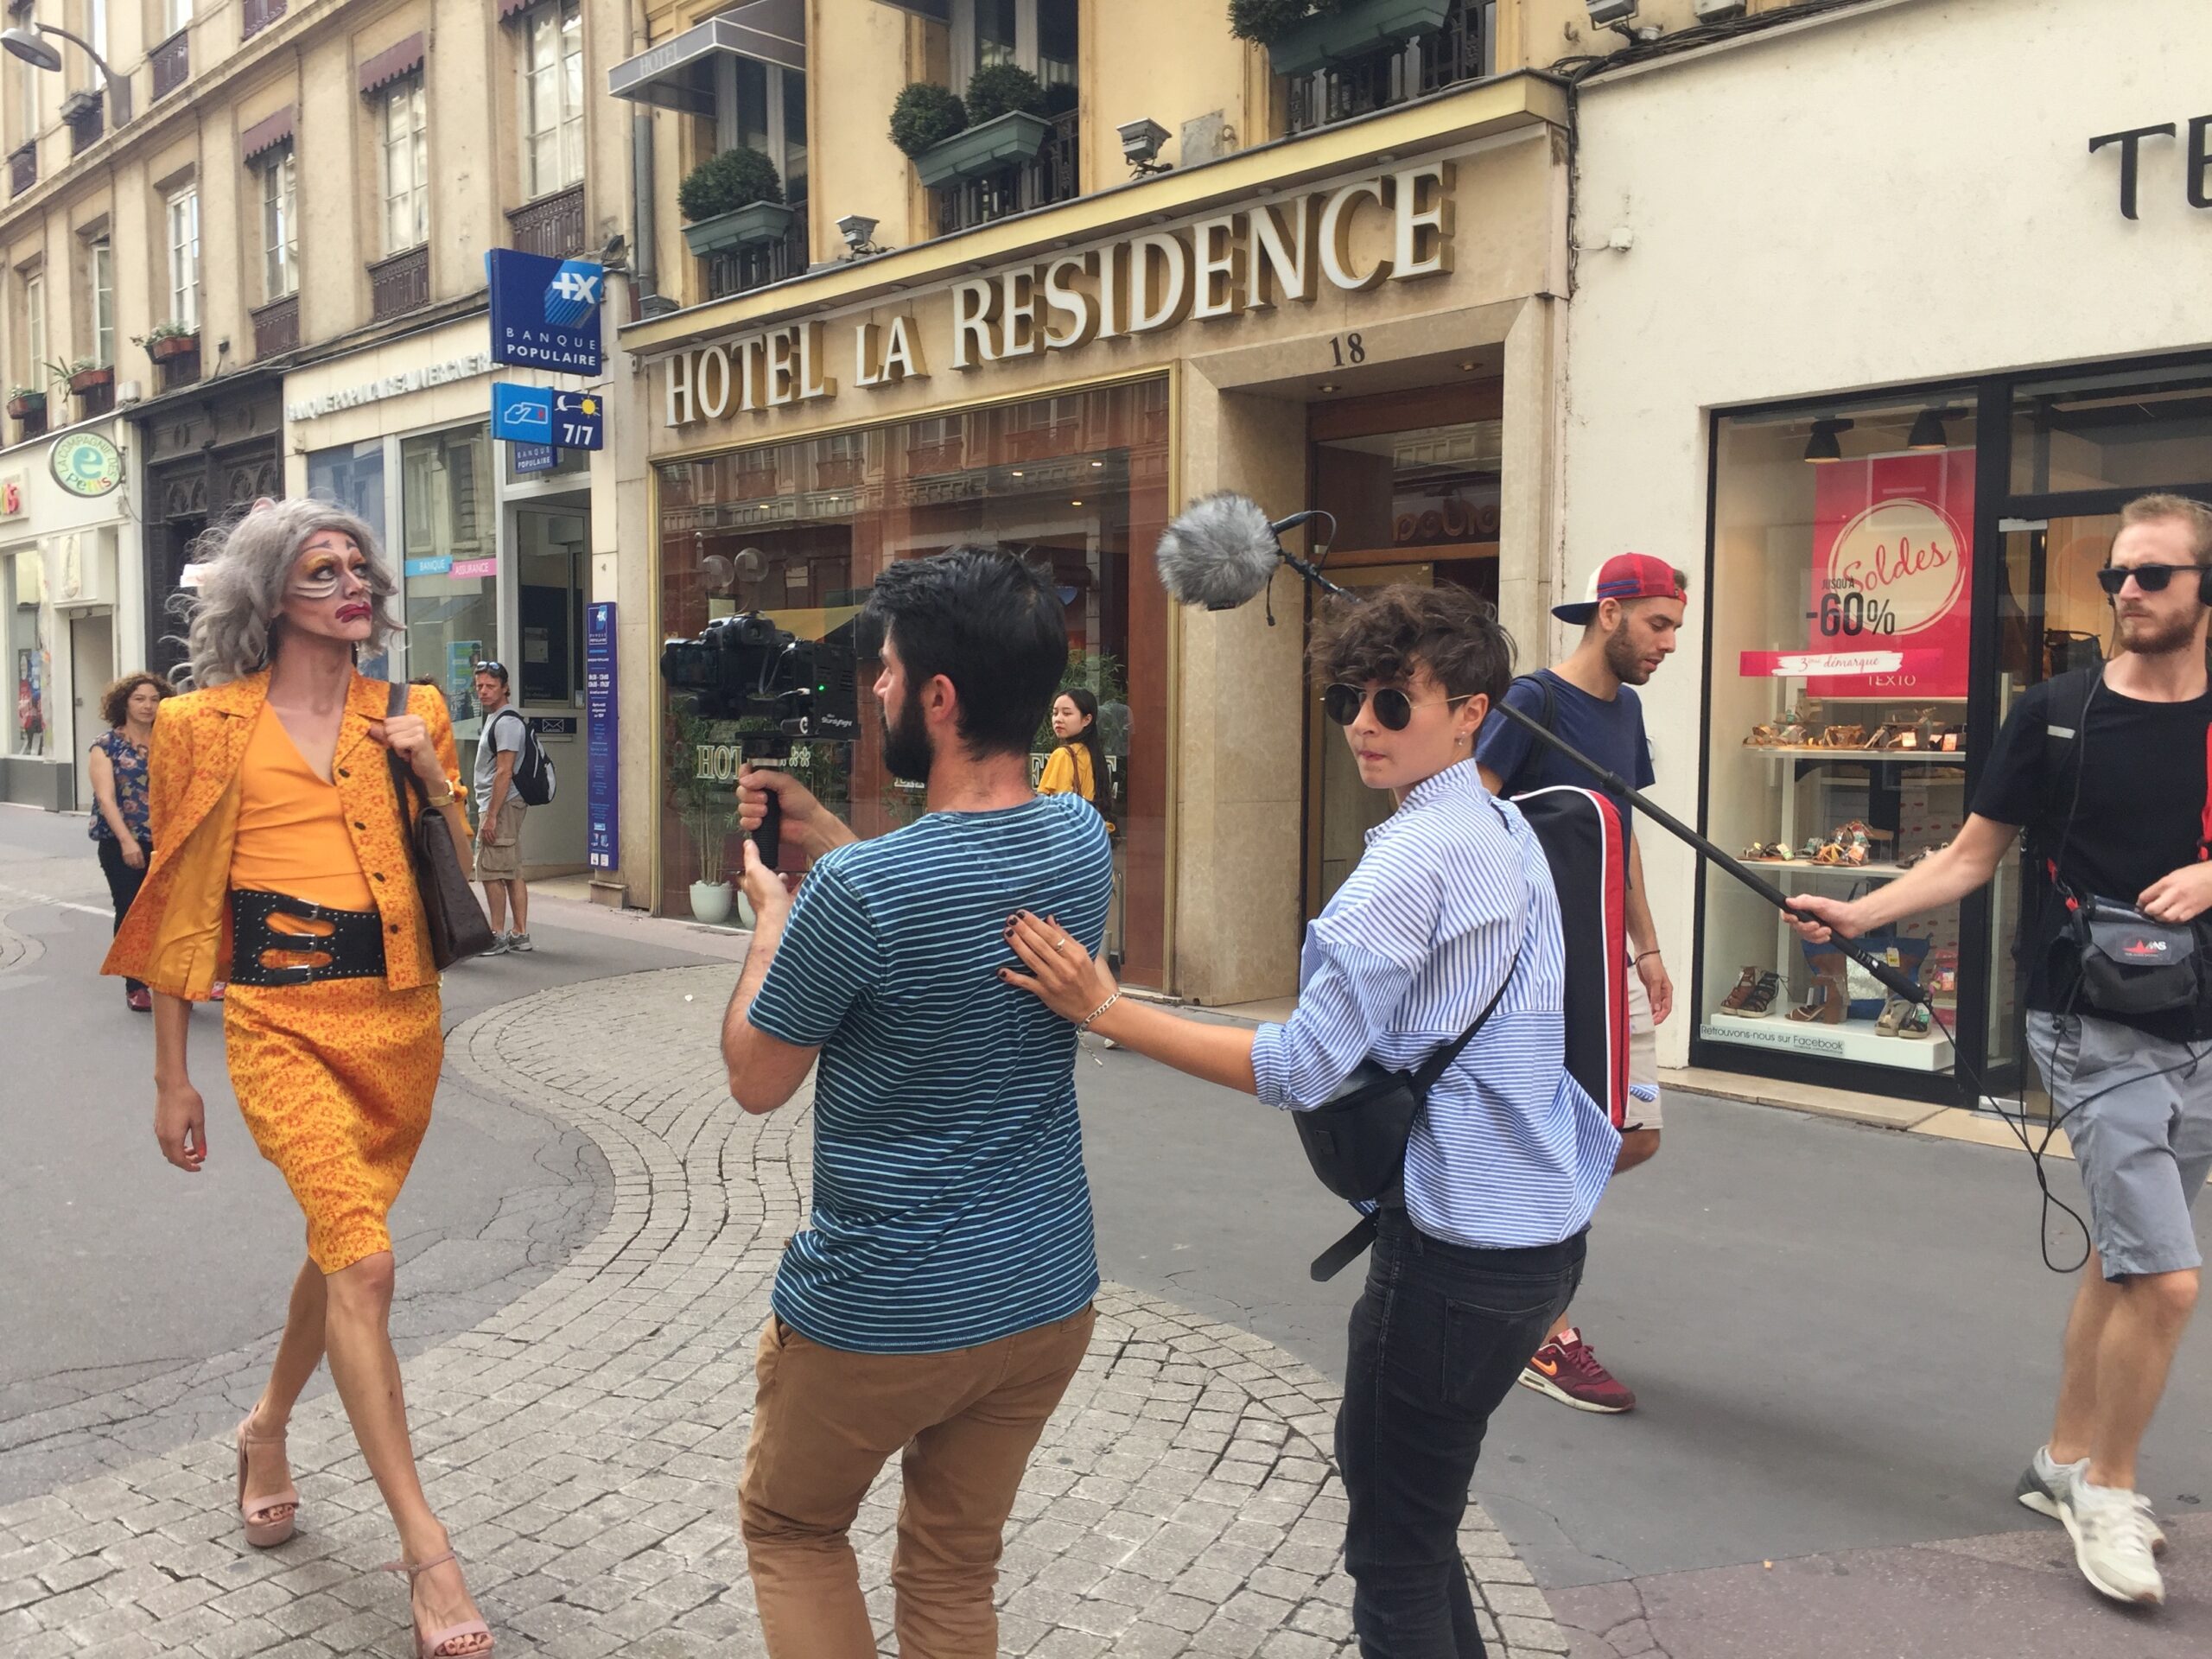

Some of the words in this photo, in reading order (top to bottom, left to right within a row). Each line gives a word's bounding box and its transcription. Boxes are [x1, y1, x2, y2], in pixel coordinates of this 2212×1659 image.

[640, 41, 680, 76] HOTEL
[664, 321, 836, 428] HOTEL
[855, 315, 931, 387] LA
[950, 161, 1457, 370] RESIDENCE
[505, 327, 595, 350] BANQUE
[1329, 333, 1366, 367] 18
[506, 344, 595, 366] POPULAIRE
[563, 423, 594, 446] 7/7
[58, 435, 111, 459] COMPAGNIE
[518, 446, 550, 459] BANQUE
[57, 459, 69, 473] LA
[108, 457, 119, 477] DES
[518, 456, 550, 469] POPULAIRE
[419, 559, 445, 571] BANQUE
[455, 562, 489, 575] ASSURANCE
[1843, 537, 1952, 593] Soldes
[1806, 591, 1895, 637] -60%
[1823, 655, 1879, 674] démarque
[696, 745, 742, 779] HOT
[1700, 1026, 1775, 1041] Retrouvons-nous
[1777, 1034, 1792, 1044] sur
[1793, 1036, 1843, 1051] Facebook
